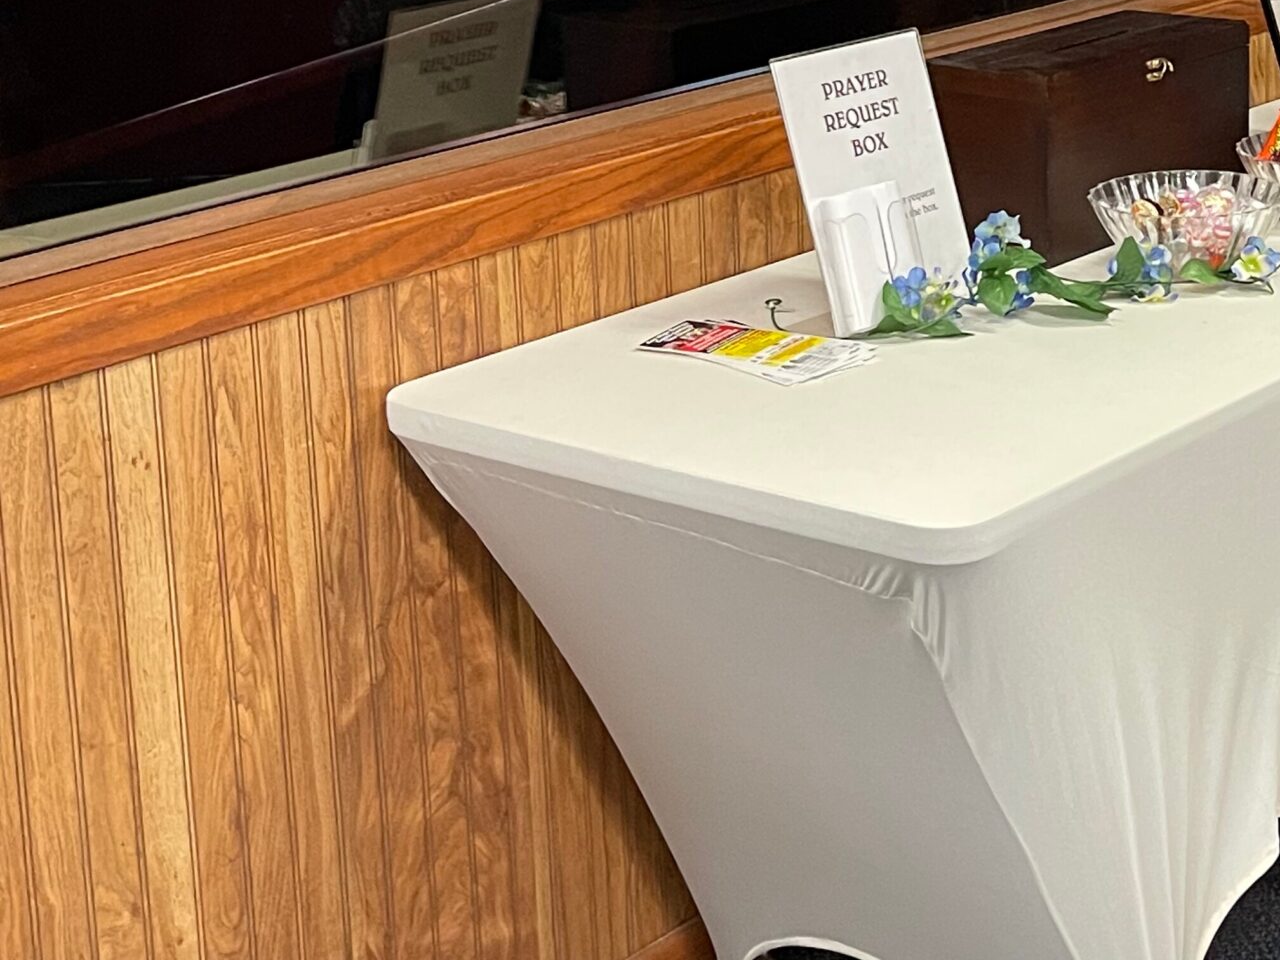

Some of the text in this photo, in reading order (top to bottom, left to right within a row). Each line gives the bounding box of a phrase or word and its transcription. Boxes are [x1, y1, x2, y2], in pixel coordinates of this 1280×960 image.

[821, 68, 889, 101] PRAYER
[823, 96, 900, 133] REQUEST
[851, 131, 889, 158] BOX
